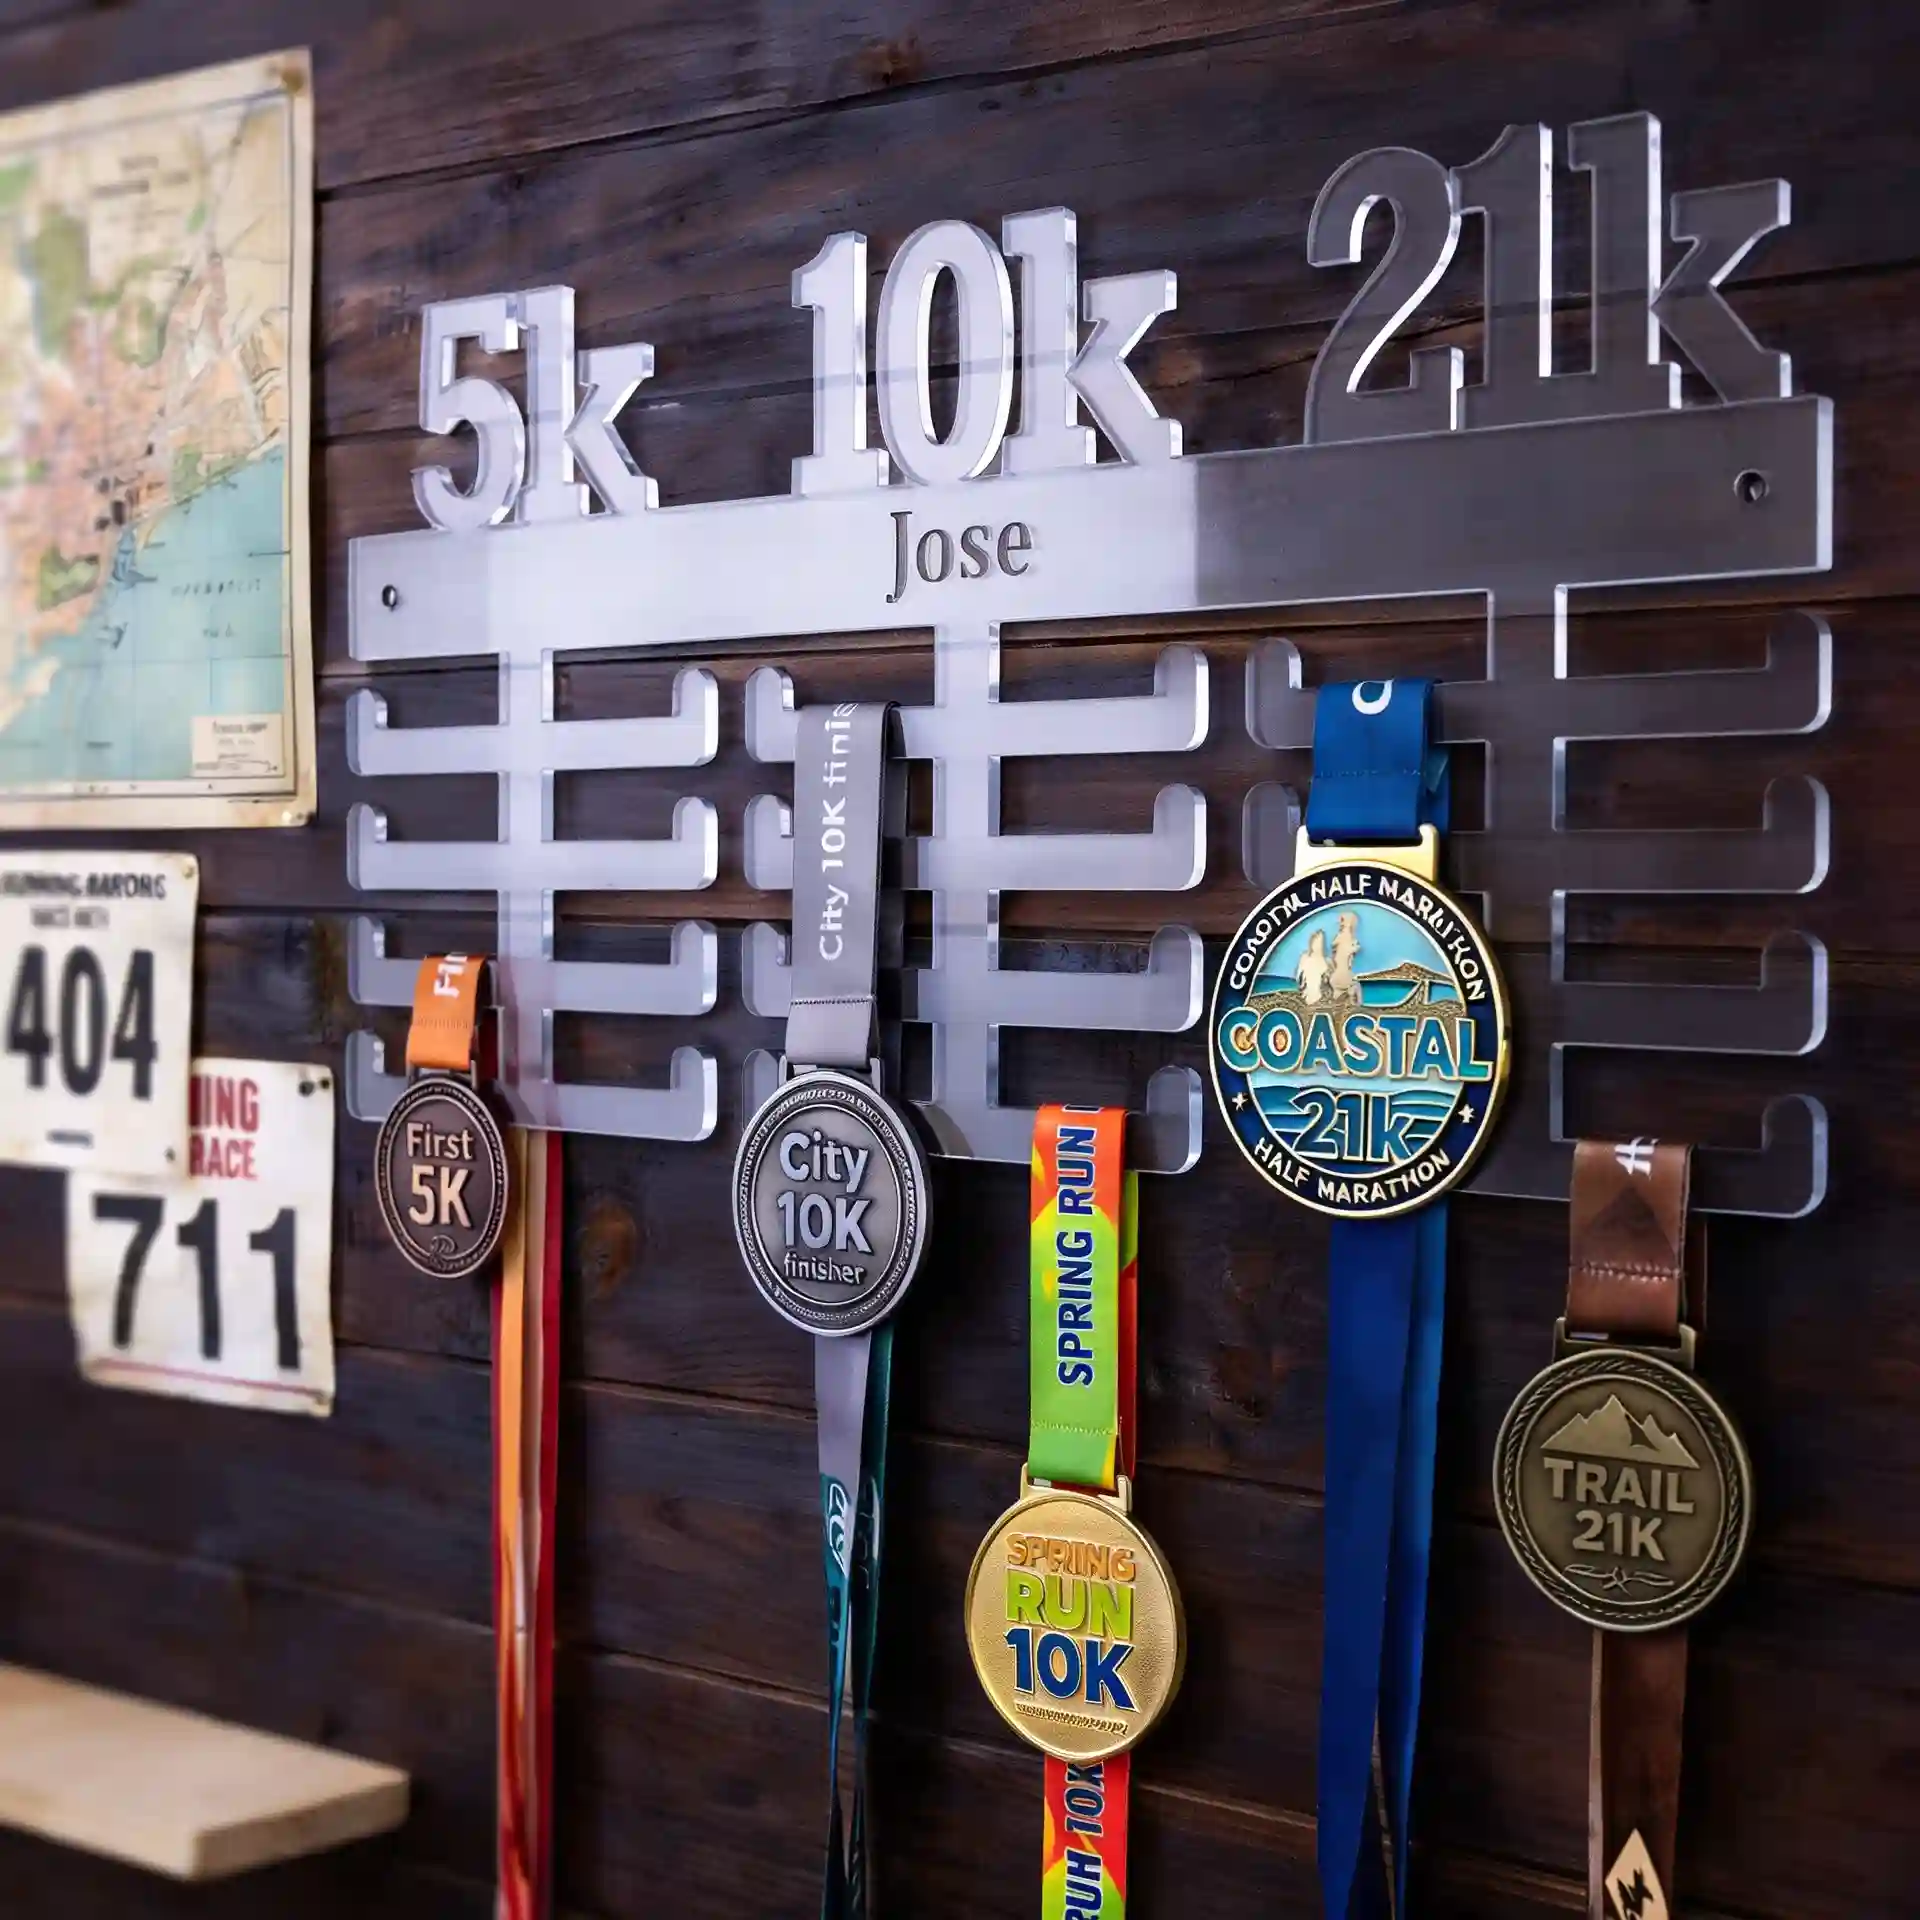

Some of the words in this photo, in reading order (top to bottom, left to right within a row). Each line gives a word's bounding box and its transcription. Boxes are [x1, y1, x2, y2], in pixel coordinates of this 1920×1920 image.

[1305, 110, 1794, 444] 21k
[791, 206, 1183, 487] 10k
[411, 284, 660, 530] 5k
[886, 510, 1034, 604] Jose
[820, 796, 847, 873] 10K
[7, 943, 159, 1101] 404
[1216, 1004, 1495, 1082] COASTAL
[406, 1121, 475, 1162] First
[778, 1129, 869, 1193] City
[1056, 1125, 1097, 1216] RUN
[1254, 1137, 1311, 1188] HALF
[1317, 1147, 1450, 1205] MARATHON
[408, 1163, 472, 1229] 5K
[776, 1190, 874, 1254] 10K
[92, 1192, 300, 1370] 711
[783, 1251, 865, 1285] finisher
[1056, 1230, 1095, 1388] SPRING
[1542, 1456, 1695, 1515] TRAIL
[1006, 1532, 1138, 1584] SPRING
[1570, 1508, 1666, 1562] 21K
[1004, 1567, 1138, 1642] RUN
[1003, 1627, 1140, 1713] 10K
